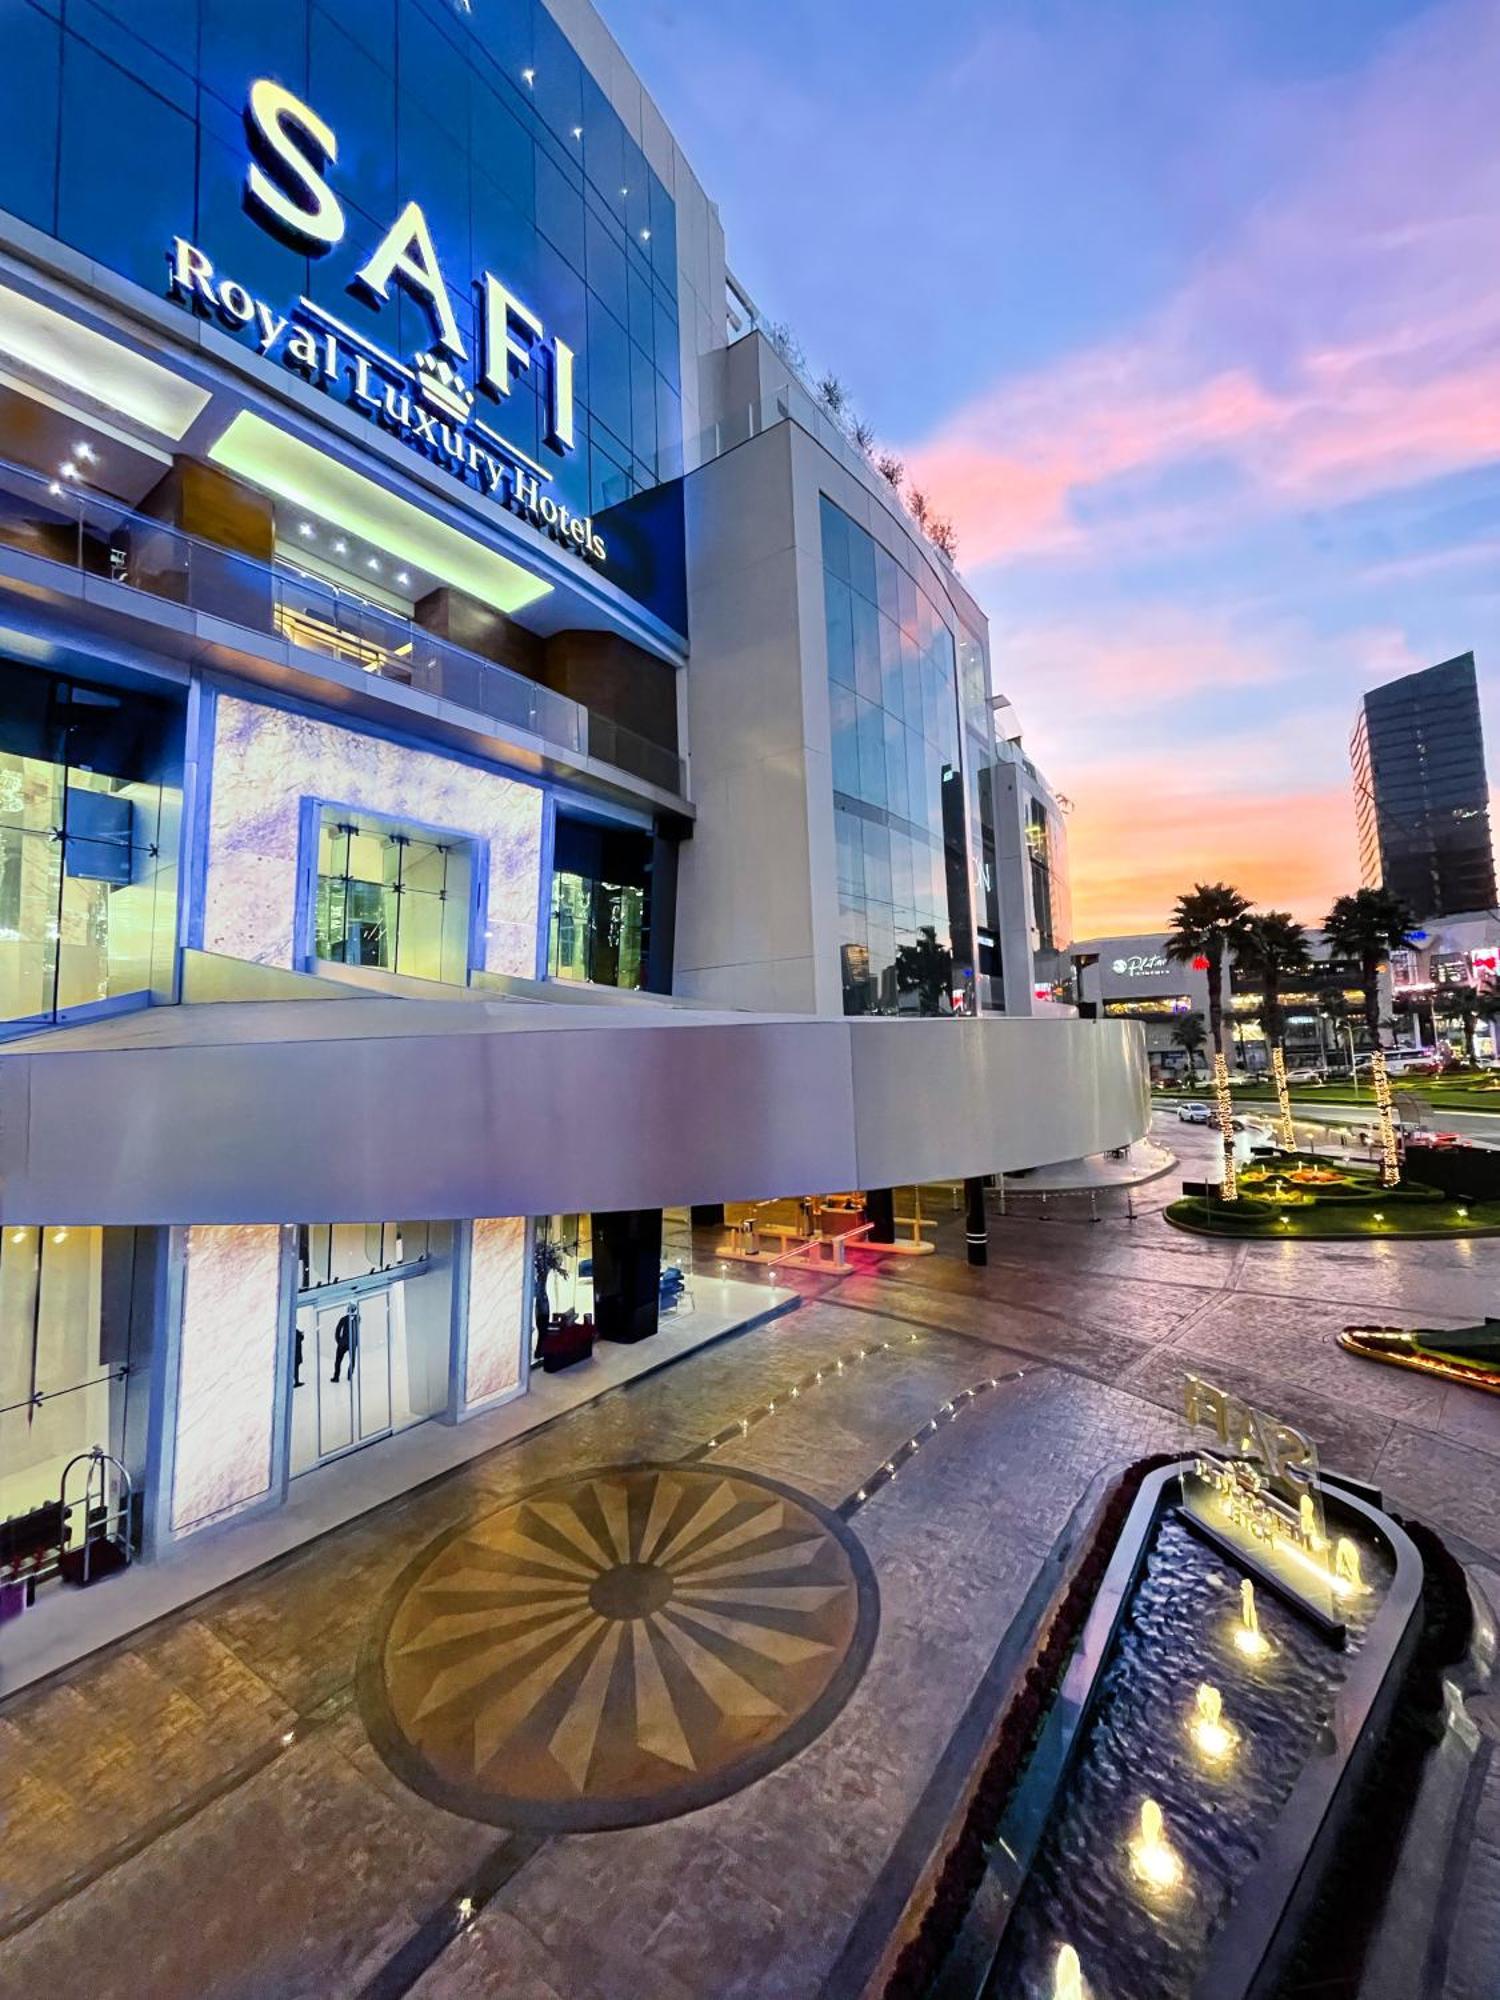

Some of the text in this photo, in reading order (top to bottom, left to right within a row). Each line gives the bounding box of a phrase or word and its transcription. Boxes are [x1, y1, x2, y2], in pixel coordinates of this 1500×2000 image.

[172, 235, 607, 560] Royal Luxury Hotels
[249, 78, 576, 452] SAFI
